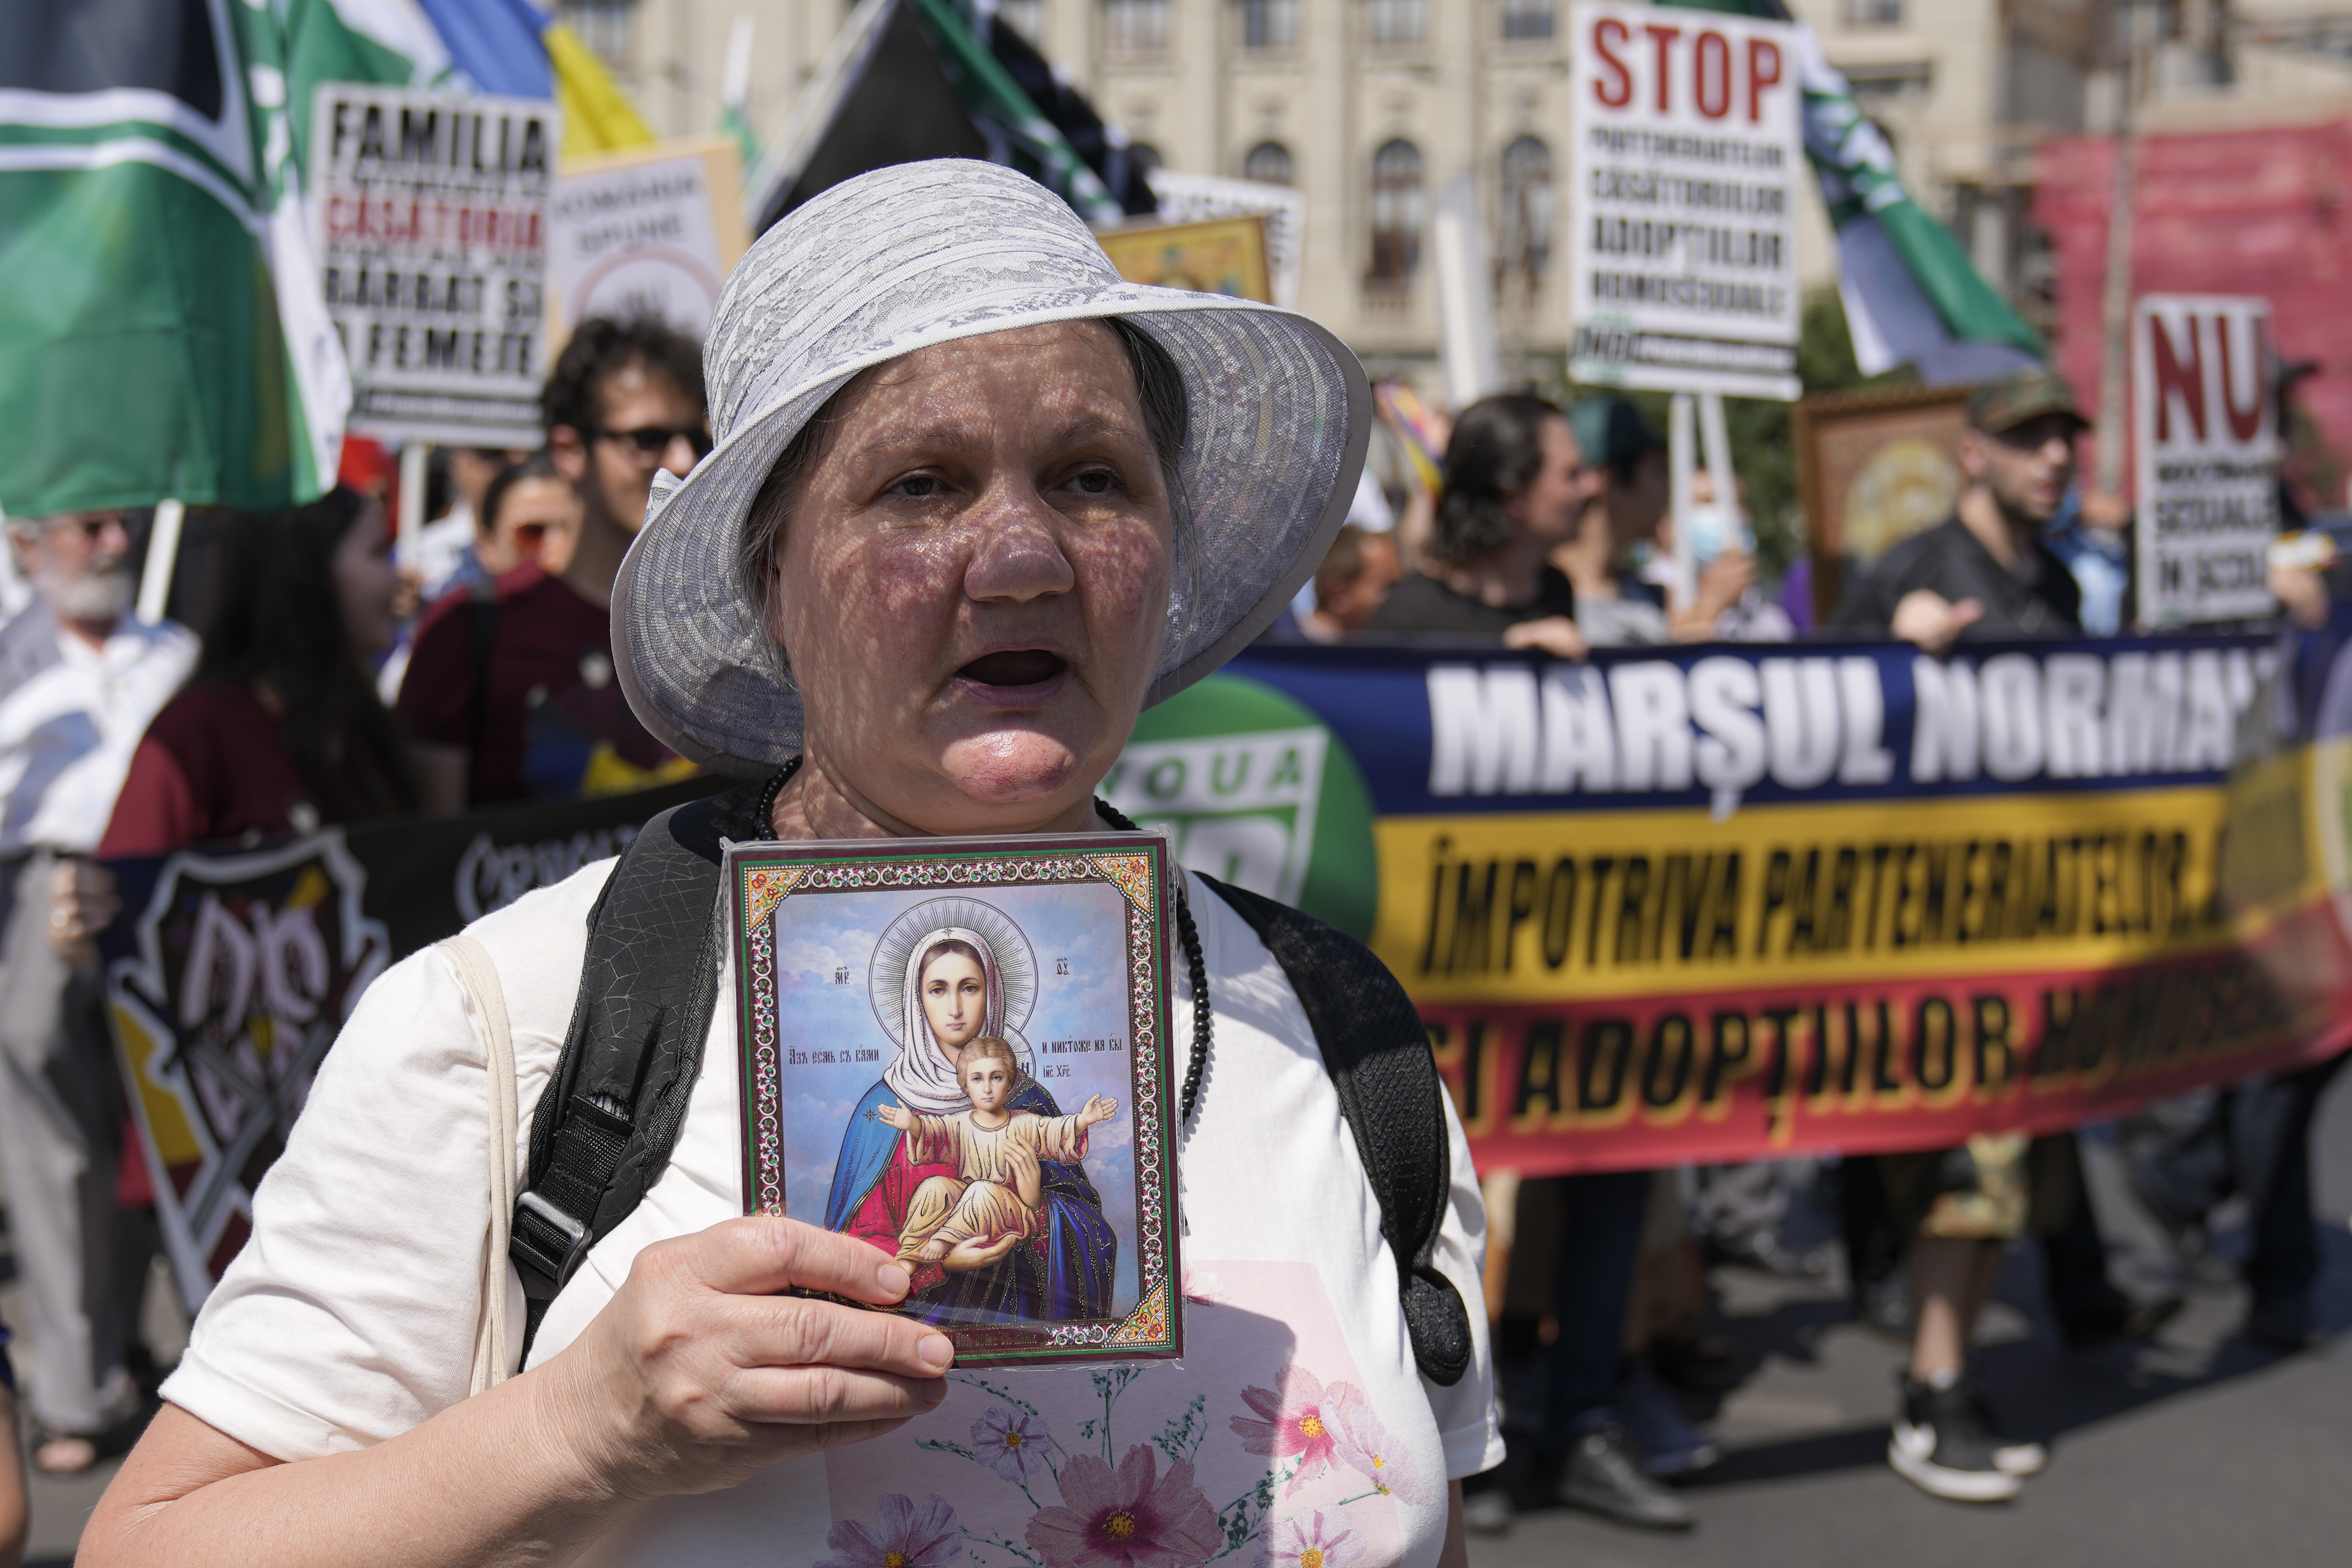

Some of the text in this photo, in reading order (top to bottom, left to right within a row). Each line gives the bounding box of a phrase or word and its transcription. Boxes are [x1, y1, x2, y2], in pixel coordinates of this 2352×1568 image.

[1591, 15, 1783, 124] STOP
[328, 97, 550, 177] FAMILIA
[2149, 313, 2264, 443] NU
[1427, 654, 1896, 825] MARȘUL
[1420, 832, 1747, 977] ÎMPOTRIVA
